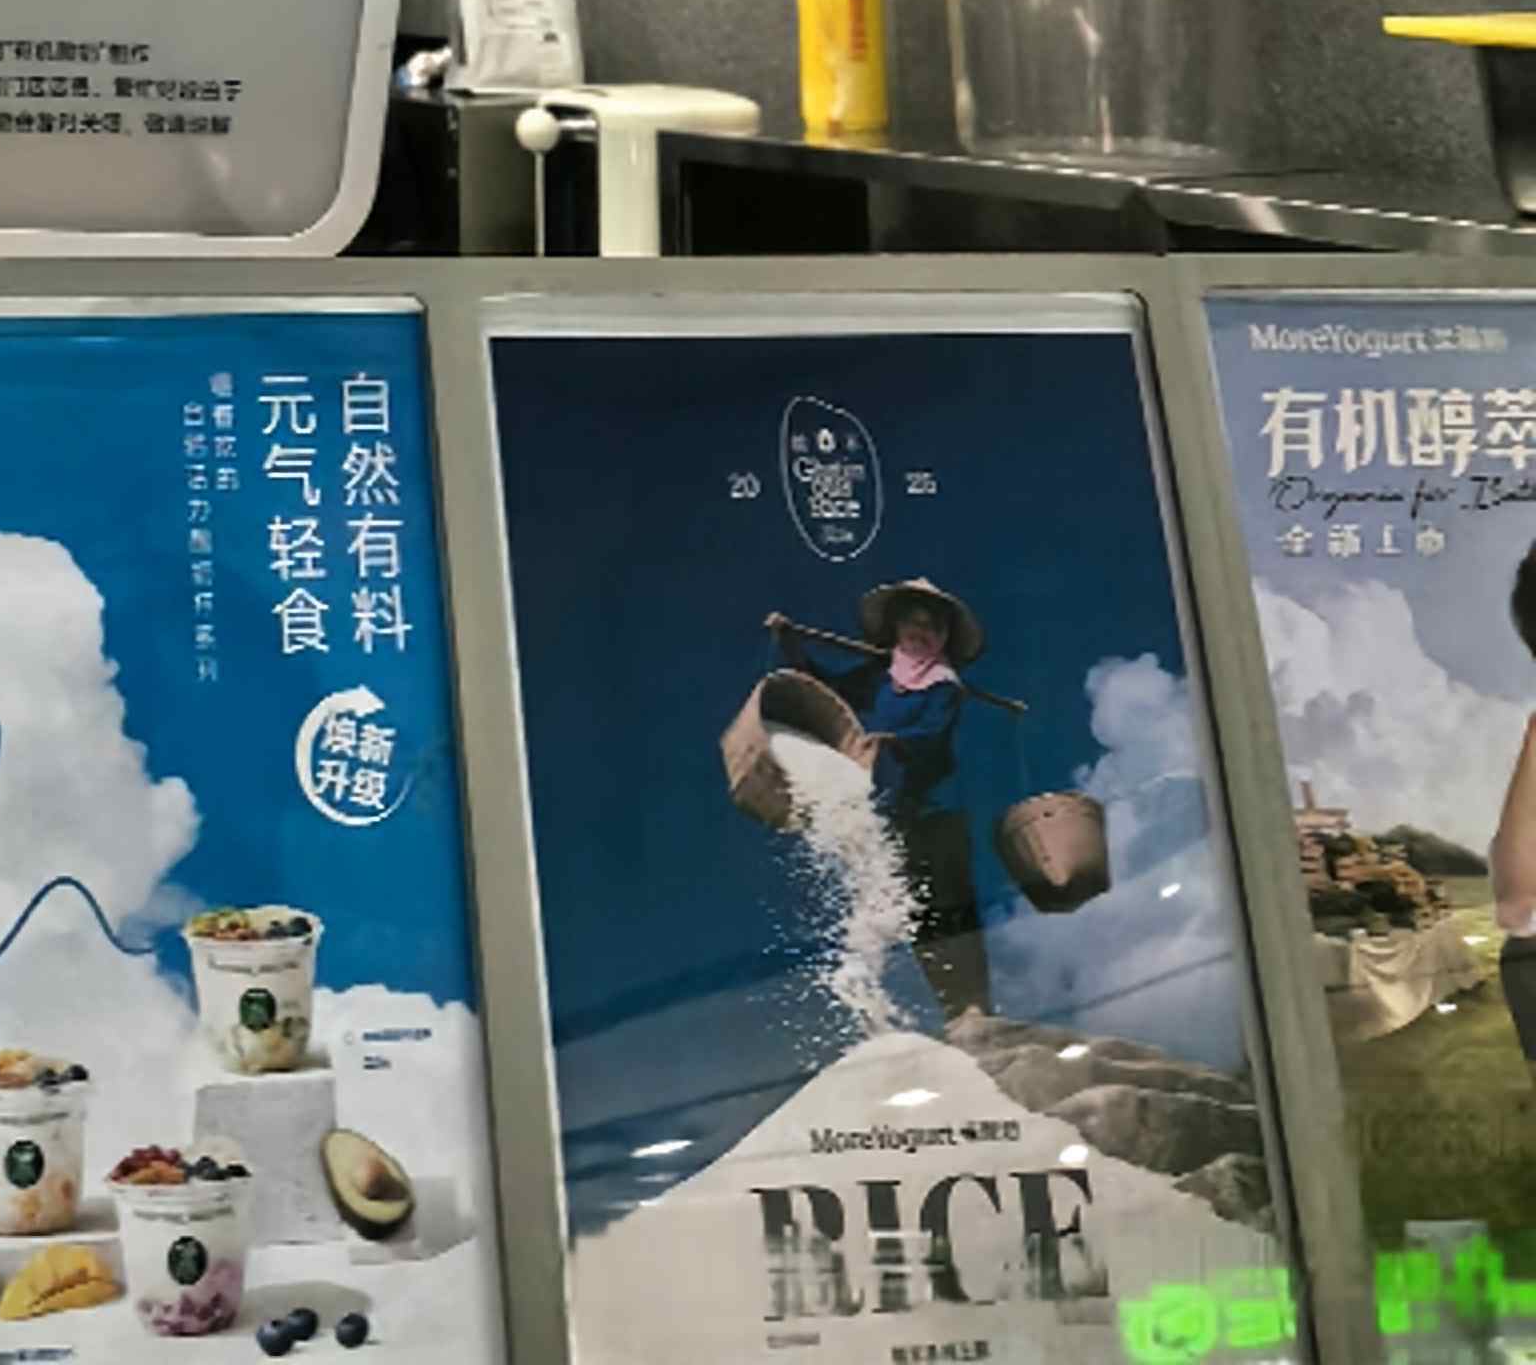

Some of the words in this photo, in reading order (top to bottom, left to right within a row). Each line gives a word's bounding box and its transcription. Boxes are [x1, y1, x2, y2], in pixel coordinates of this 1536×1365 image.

[1247, 323, 1428, 359] MoreYogurt
[257, 376, 331, 654] 元气轻食
[340, 372, 413, 654] 自然有料
[727, 470, 761, 499] 20
[316, 759, 389, 810] 升级
[749, 1167, 1110, 1322] RICE
